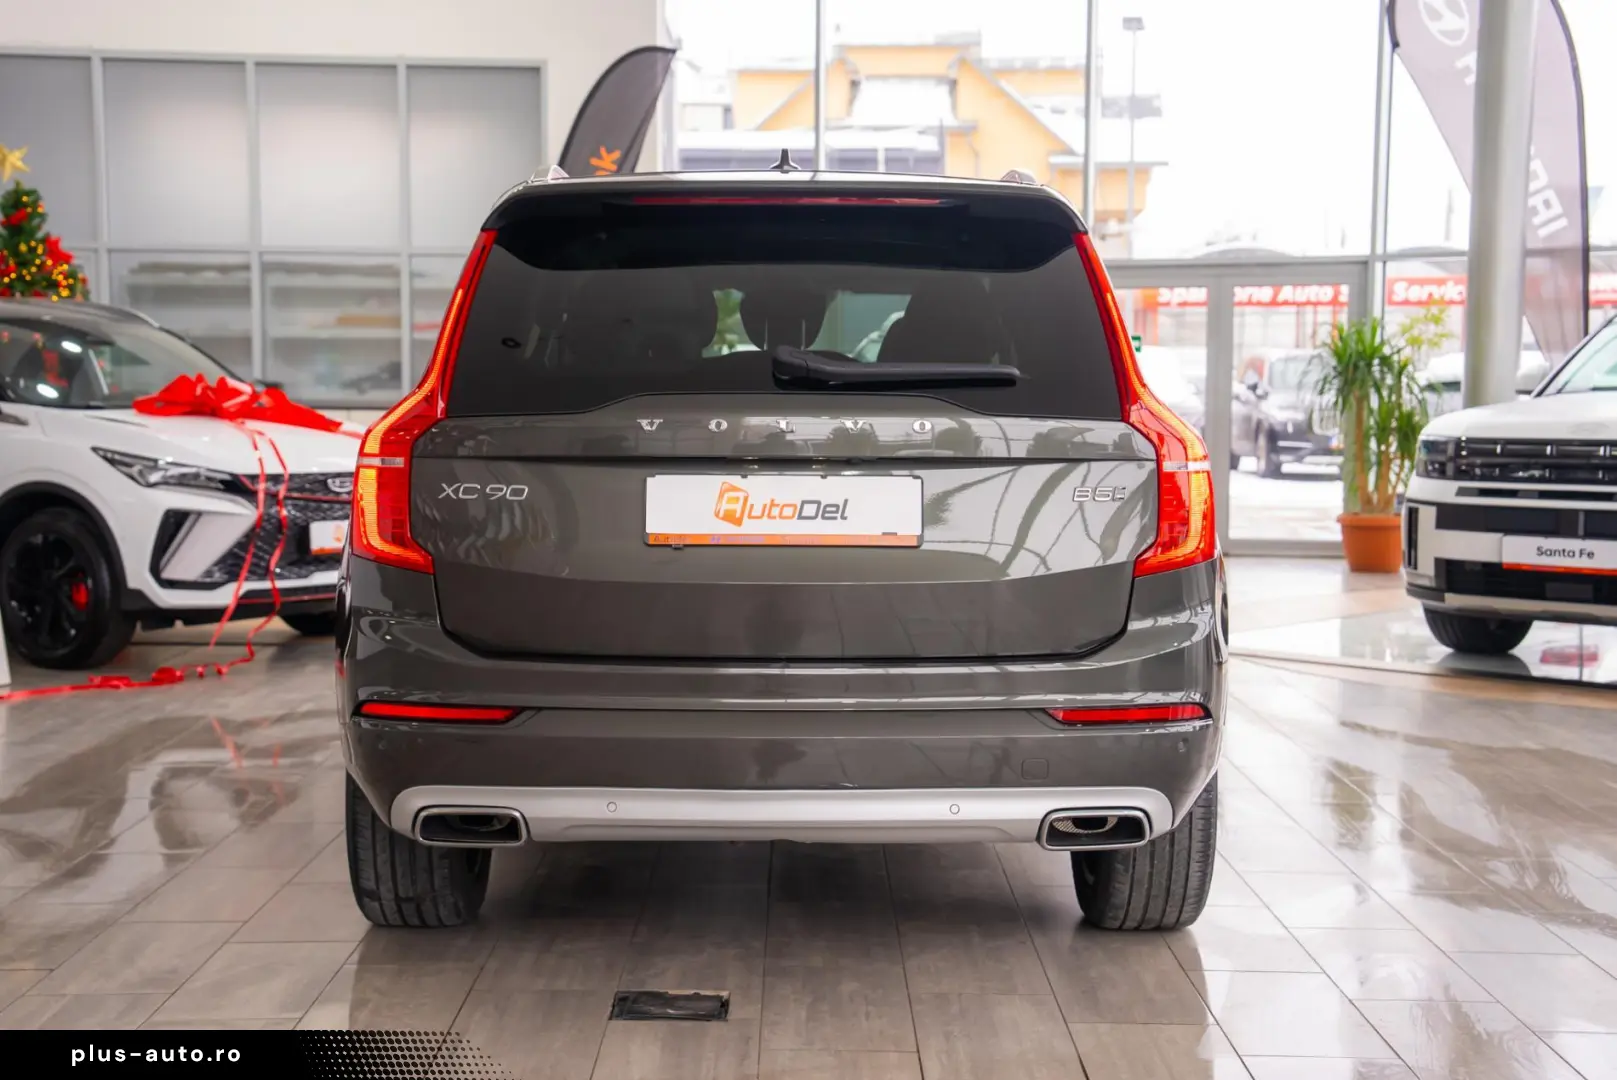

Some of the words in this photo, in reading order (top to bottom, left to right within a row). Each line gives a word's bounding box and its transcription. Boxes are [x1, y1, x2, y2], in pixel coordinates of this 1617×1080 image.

[1277, 284, 1334, 303] Auto
[637, 418, 933, 434] VOLVO
[716, 486, 849, 524] AutoDel
[1536, 546, 1576, 558] Santa
[1579, 548, 1595, 560] Fe
